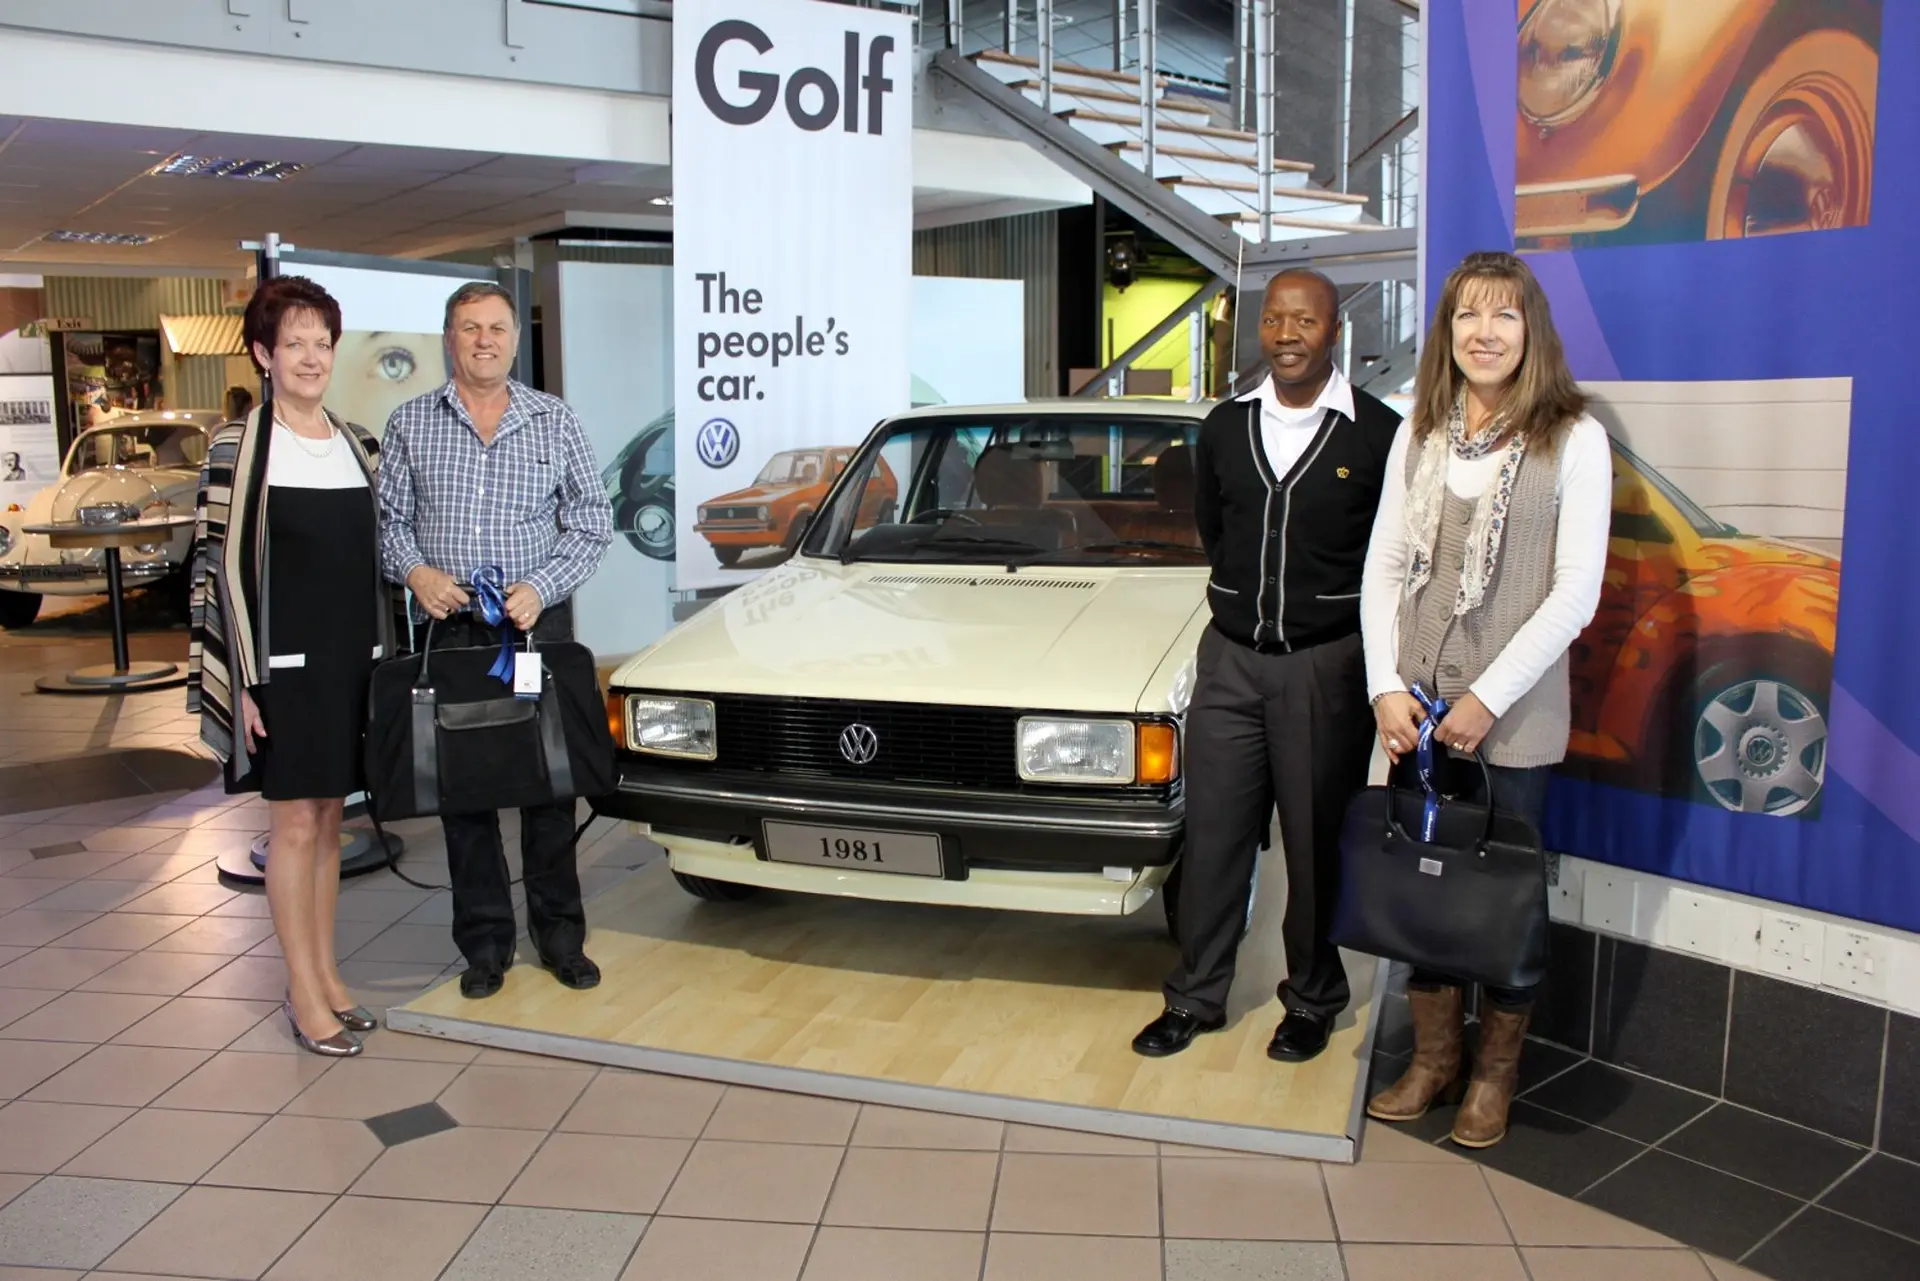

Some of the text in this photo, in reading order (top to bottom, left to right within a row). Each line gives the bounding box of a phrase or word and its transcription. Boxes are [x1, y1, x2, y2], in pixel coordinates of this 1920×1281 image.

[695, 19, 894, 135] Golf
[695, 271, 763, 315] The
[57, 319, 82, 329] Exit
[698, 315, 849, 368] people’s
[697, 375, 765, 402] car.
[840, 724, 877, 764] VW
[820, 837, 884, 863] 1981
